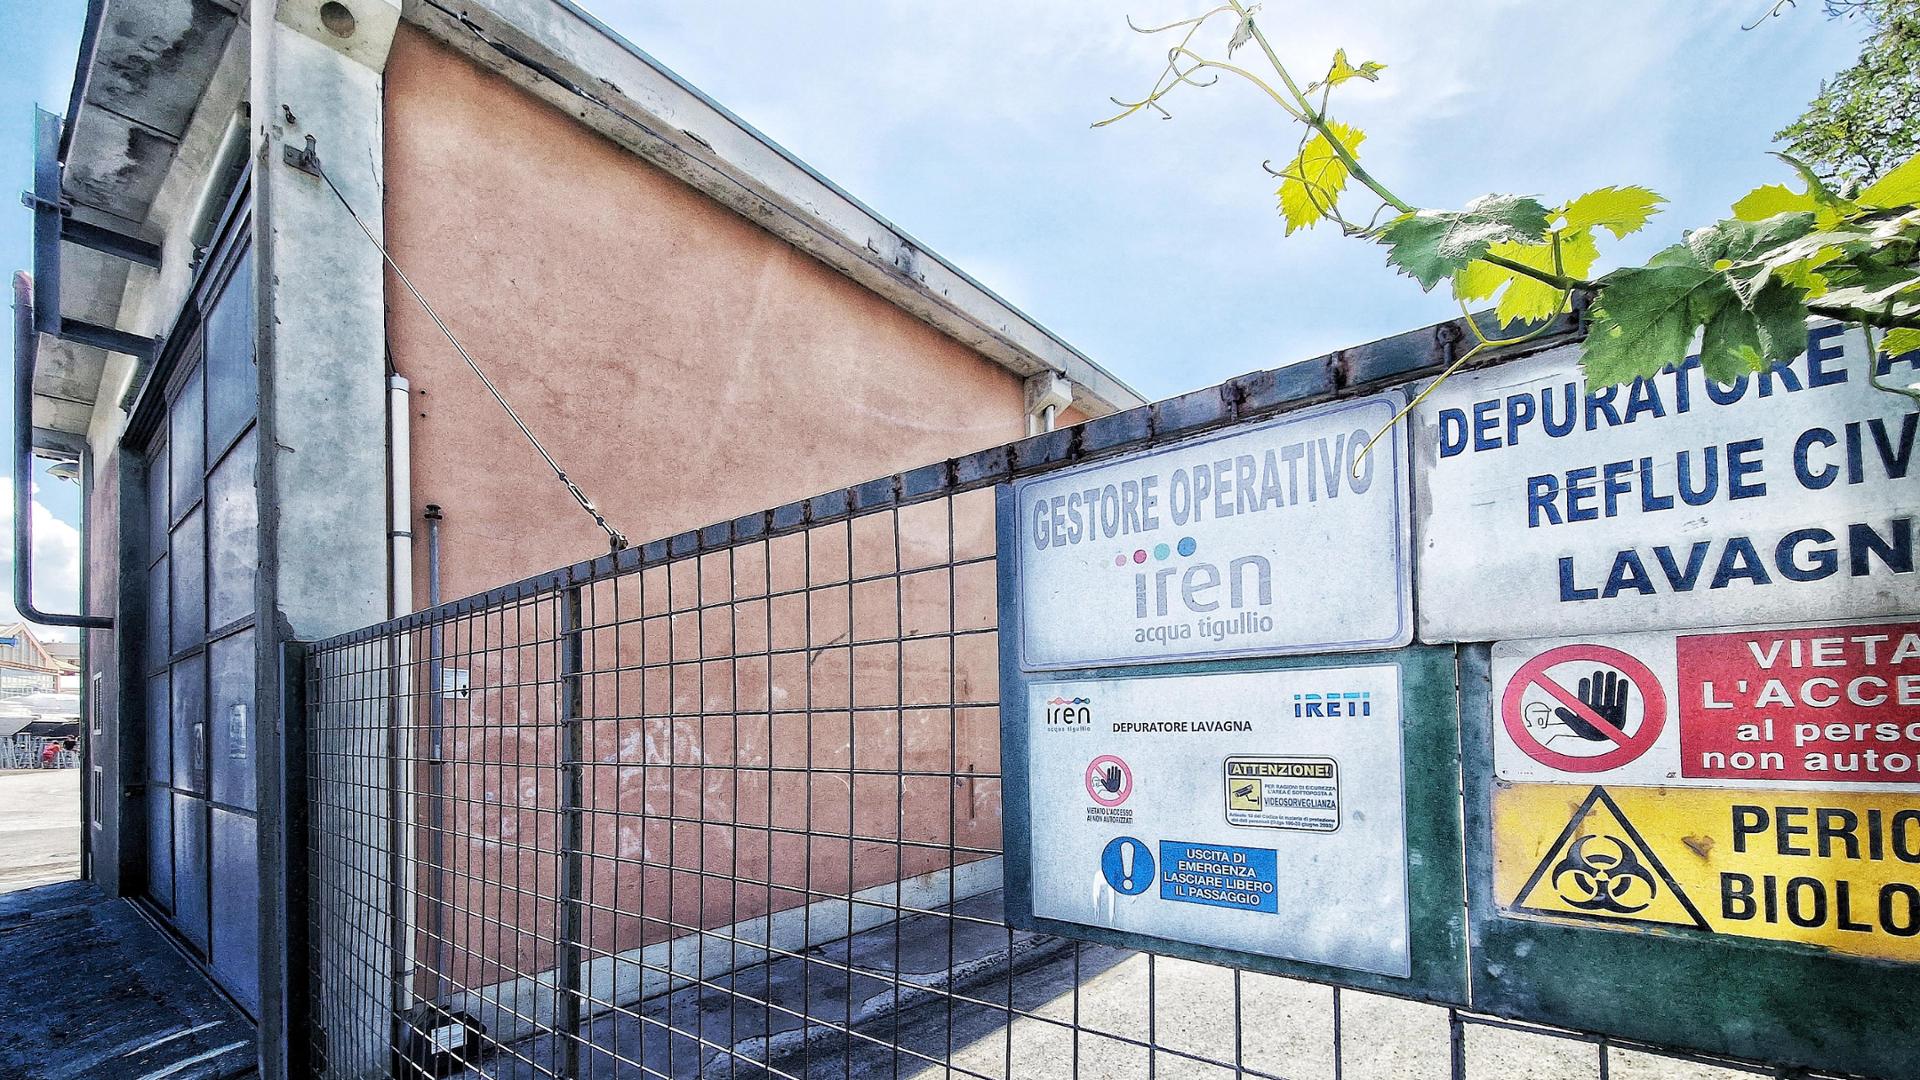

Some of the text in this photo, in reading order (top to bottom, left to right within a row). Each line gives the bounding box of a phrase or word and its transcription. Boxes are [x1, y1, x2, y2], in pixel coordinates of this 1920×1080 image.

[1528, 412, 1920, 528] REFLUE CIV
[1033, 428, 1374, 551] GESTORE OPERATIVO
[1558, 517, 1914, 602] LAVAGN
[1135, 554, 1273, 619] iren
[1135, 611, 1273, 646] acqua tigullio
[1748, 634, 1920, 669] VIETA
[1702, 675, 1920, 710] L'ACCE
[1047, 707, 1091, 724] iren
[1112, 720, 1252, 733] DEPURATORE LAVAGNA
[1736, 719, 1772, 741] al
[1232, 763, 1330, 777] ATTENZIONE!
[1702, 751, 1784, 771] non
[1086, 807, 1133, 816] VIETATO L'ACCESSO
[1264, 797, 1336, 808] VIDEOSORVEGLIANZA
[1731, 805, 1920, 864] PERIC
[1186, 849, 1246, 863] USCITA DI
[1178, 861, 1256, 878] EMERGENZA
[1164, 872, 1273, 894] LASCIARE LIBERO
[1175, 886, 1260, 905] IL PASSAGGIO
[1719, 872, 1920, 937] BIOLO
